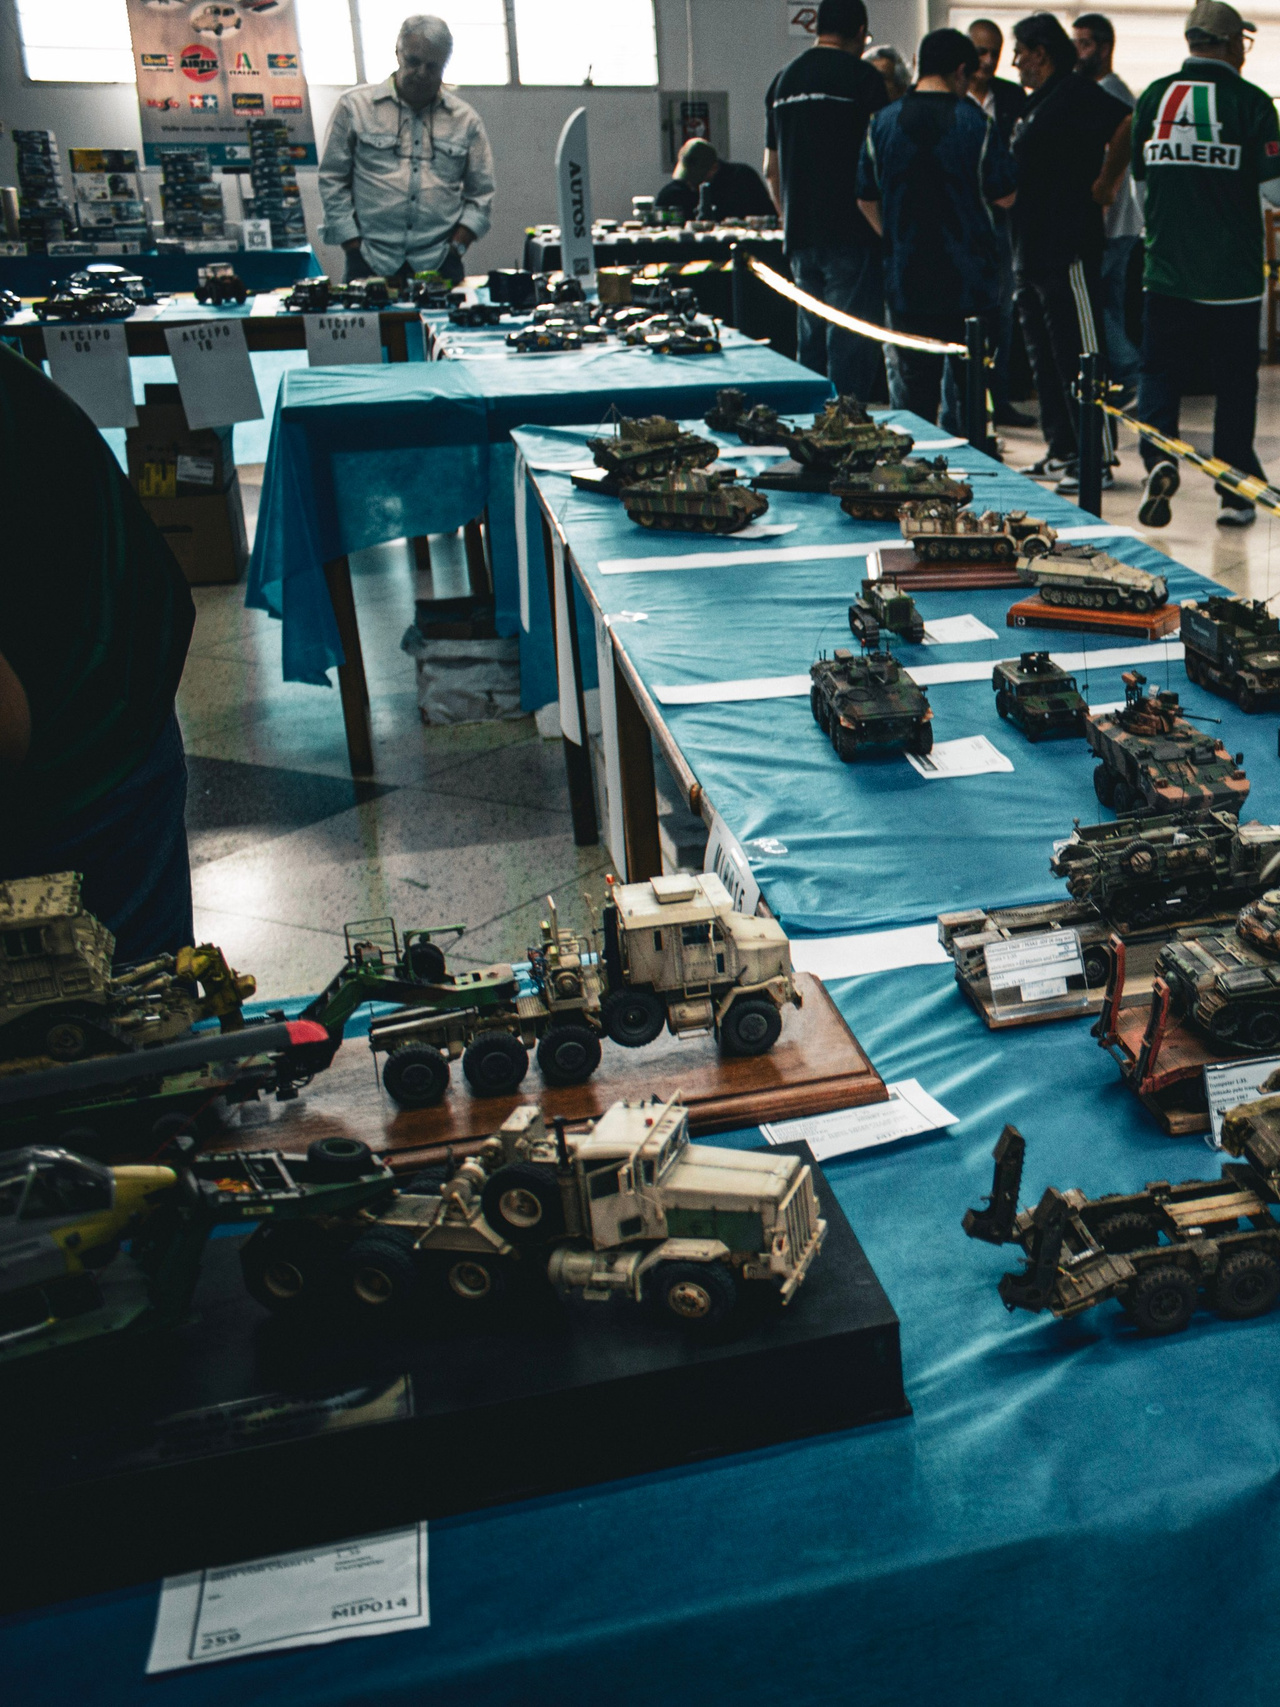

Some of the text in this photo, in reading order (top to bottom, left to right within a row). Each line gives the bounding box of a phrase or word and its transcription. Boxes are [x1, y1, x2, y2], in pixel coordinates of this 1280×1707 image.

[180, 59, 219, 69] AIRFIX
[569, 160, 587, 238] AUTOS
[332, 1596, 408, 1620] MIP014
